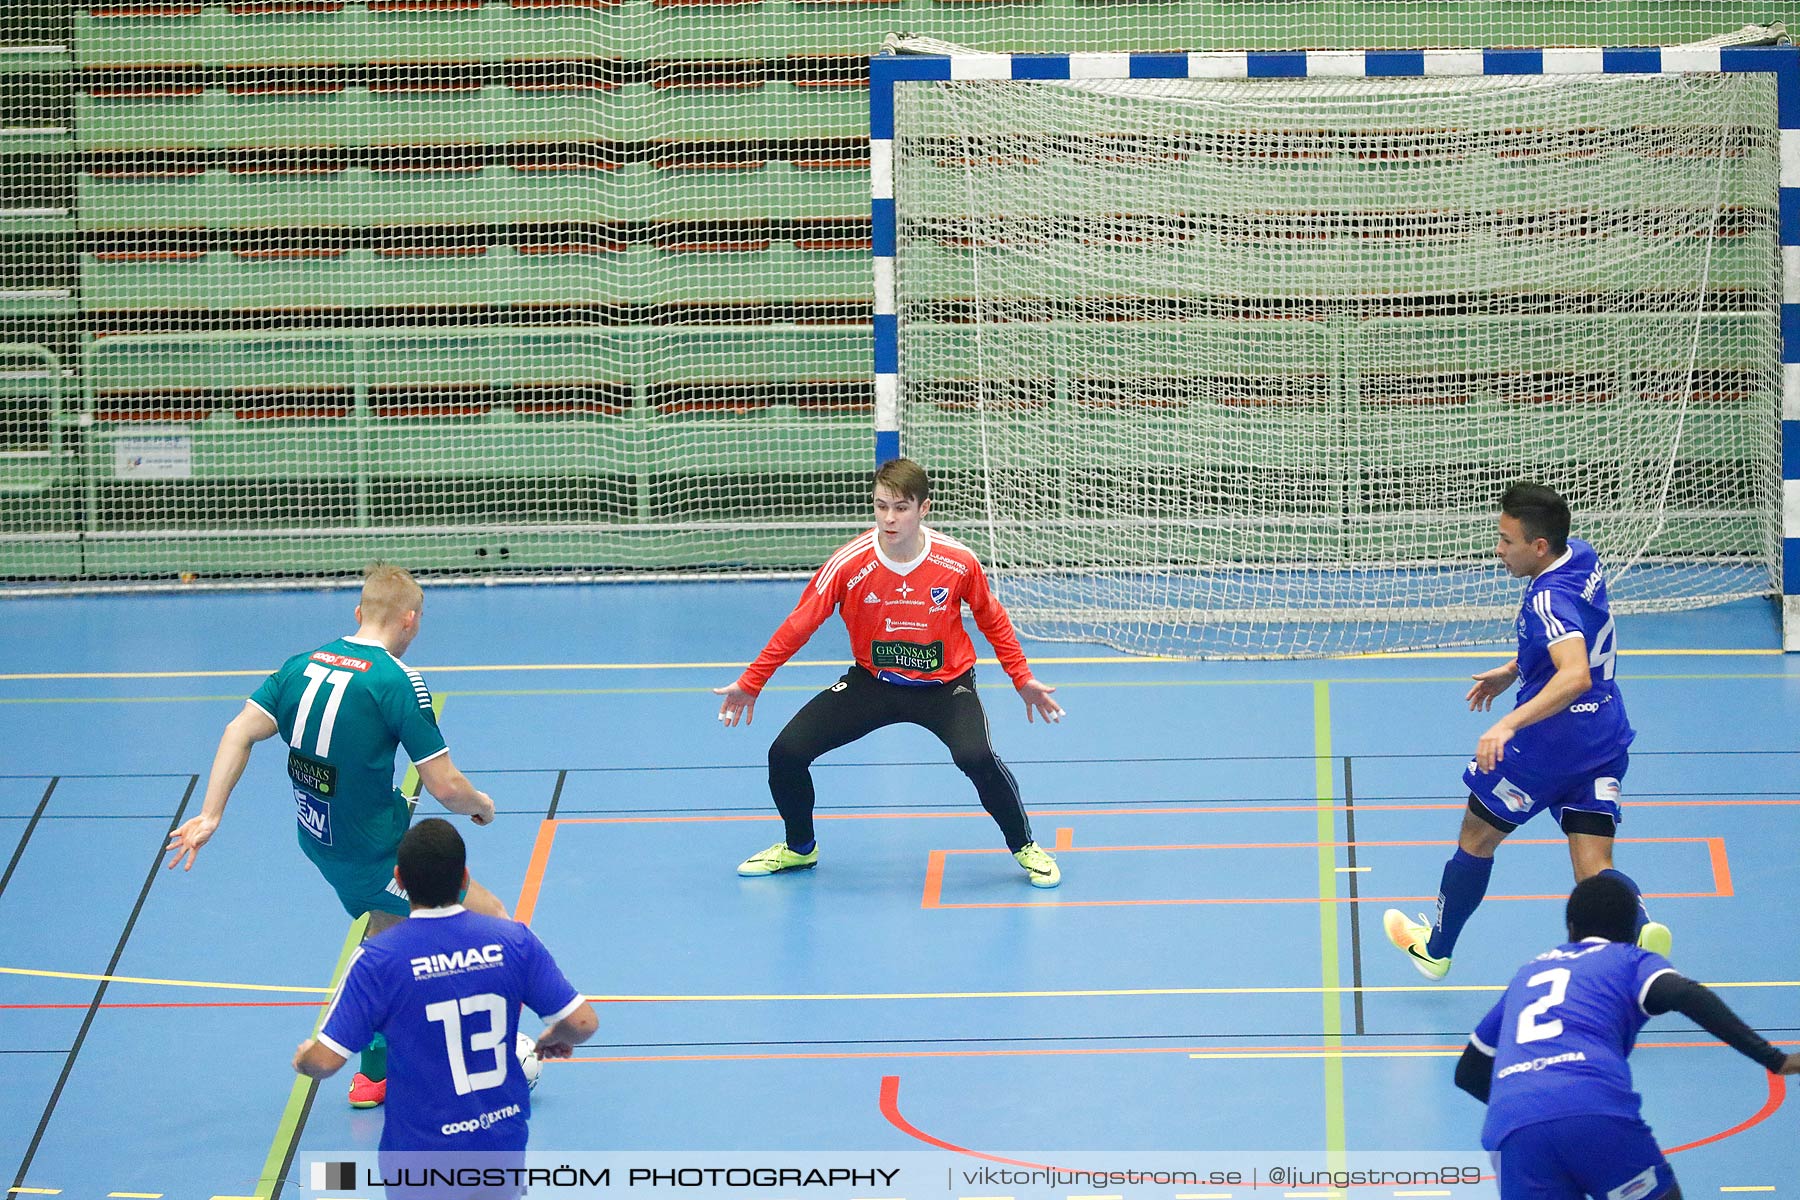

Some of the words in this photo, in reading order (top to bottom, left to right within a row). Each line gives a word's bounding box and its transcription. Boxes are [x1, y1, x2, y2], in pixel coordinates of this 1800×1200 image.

[847, 560, 879, 590] stadium
[876, 644, 937, 659] GRÖNSAKS
[1589, 608, 1617, 681] 4
[313, 652, 335, 663] coop
[342, 658, 367, 669] EXTRA
[896, 655, 932, 670] HUSET
[290, 662, 354, 759] 11
[1569, 702, 1599, 713] coop
[289, 755, 330, 780] ÖNSAKS
[1516, 967, 1571, 1044] 2
[426, 993, 507, 1096] 13
[1498, 1061, 1532, 1079] coop
[1547, 1051, 1586, 1066] EXTRA
[441, 1118, 480, 1136] coop
[488, 1104, 521, 1124] EXTRA
